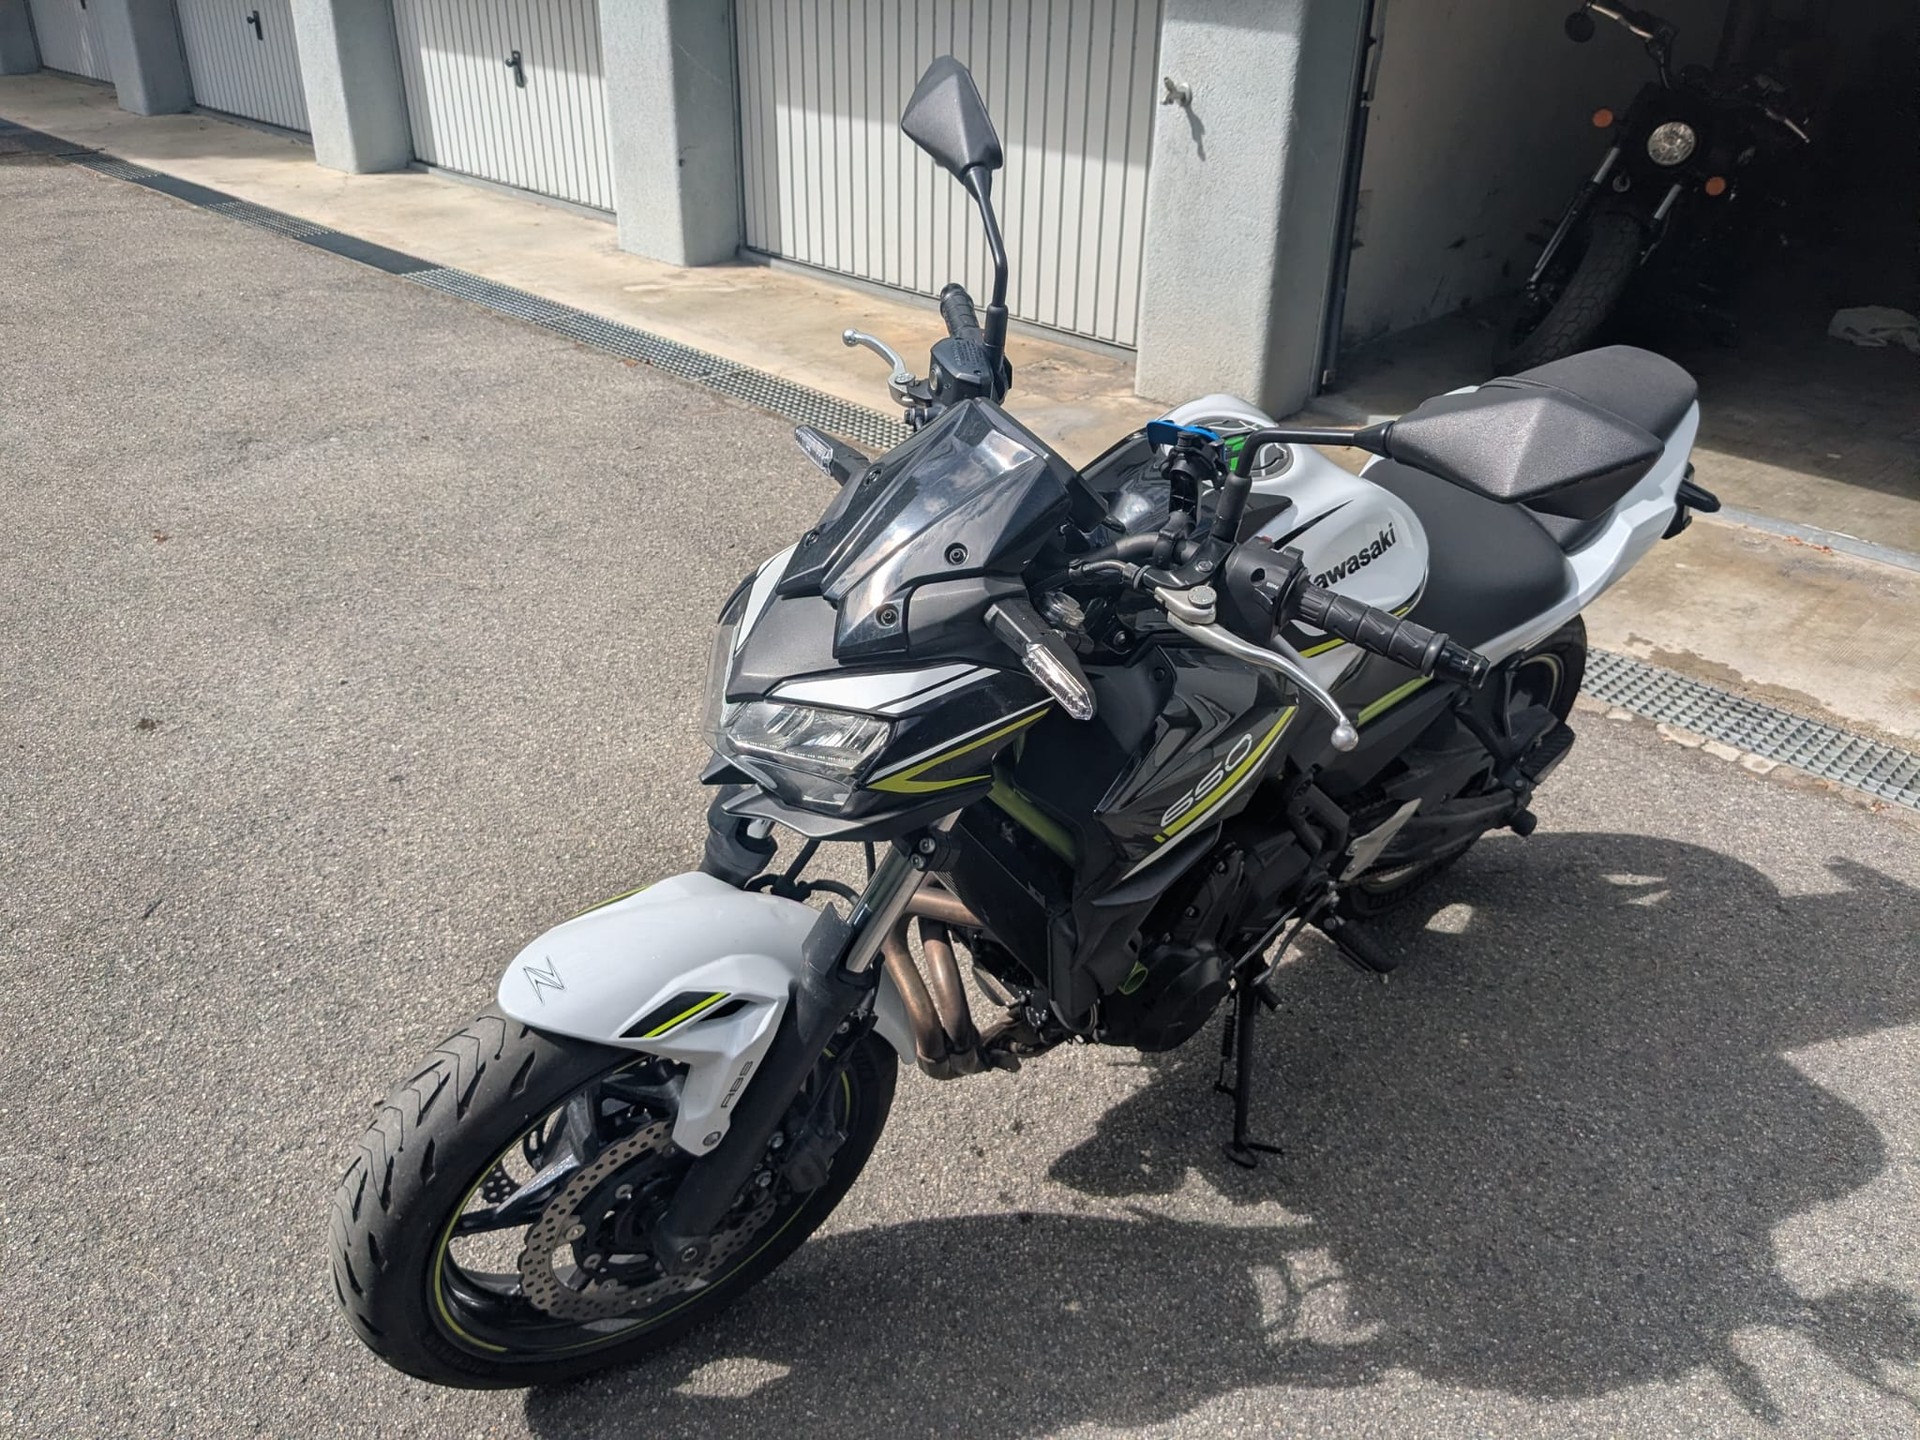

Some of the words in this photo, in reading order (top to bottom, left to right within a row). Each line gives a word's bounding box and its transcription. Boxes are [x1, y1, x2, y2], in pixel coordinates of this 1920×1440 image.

[1307, 522, 1397, 589] awasaki
[1160, 733, 1252, 827] 650
[720, 1060, 753, 1108] ABS
